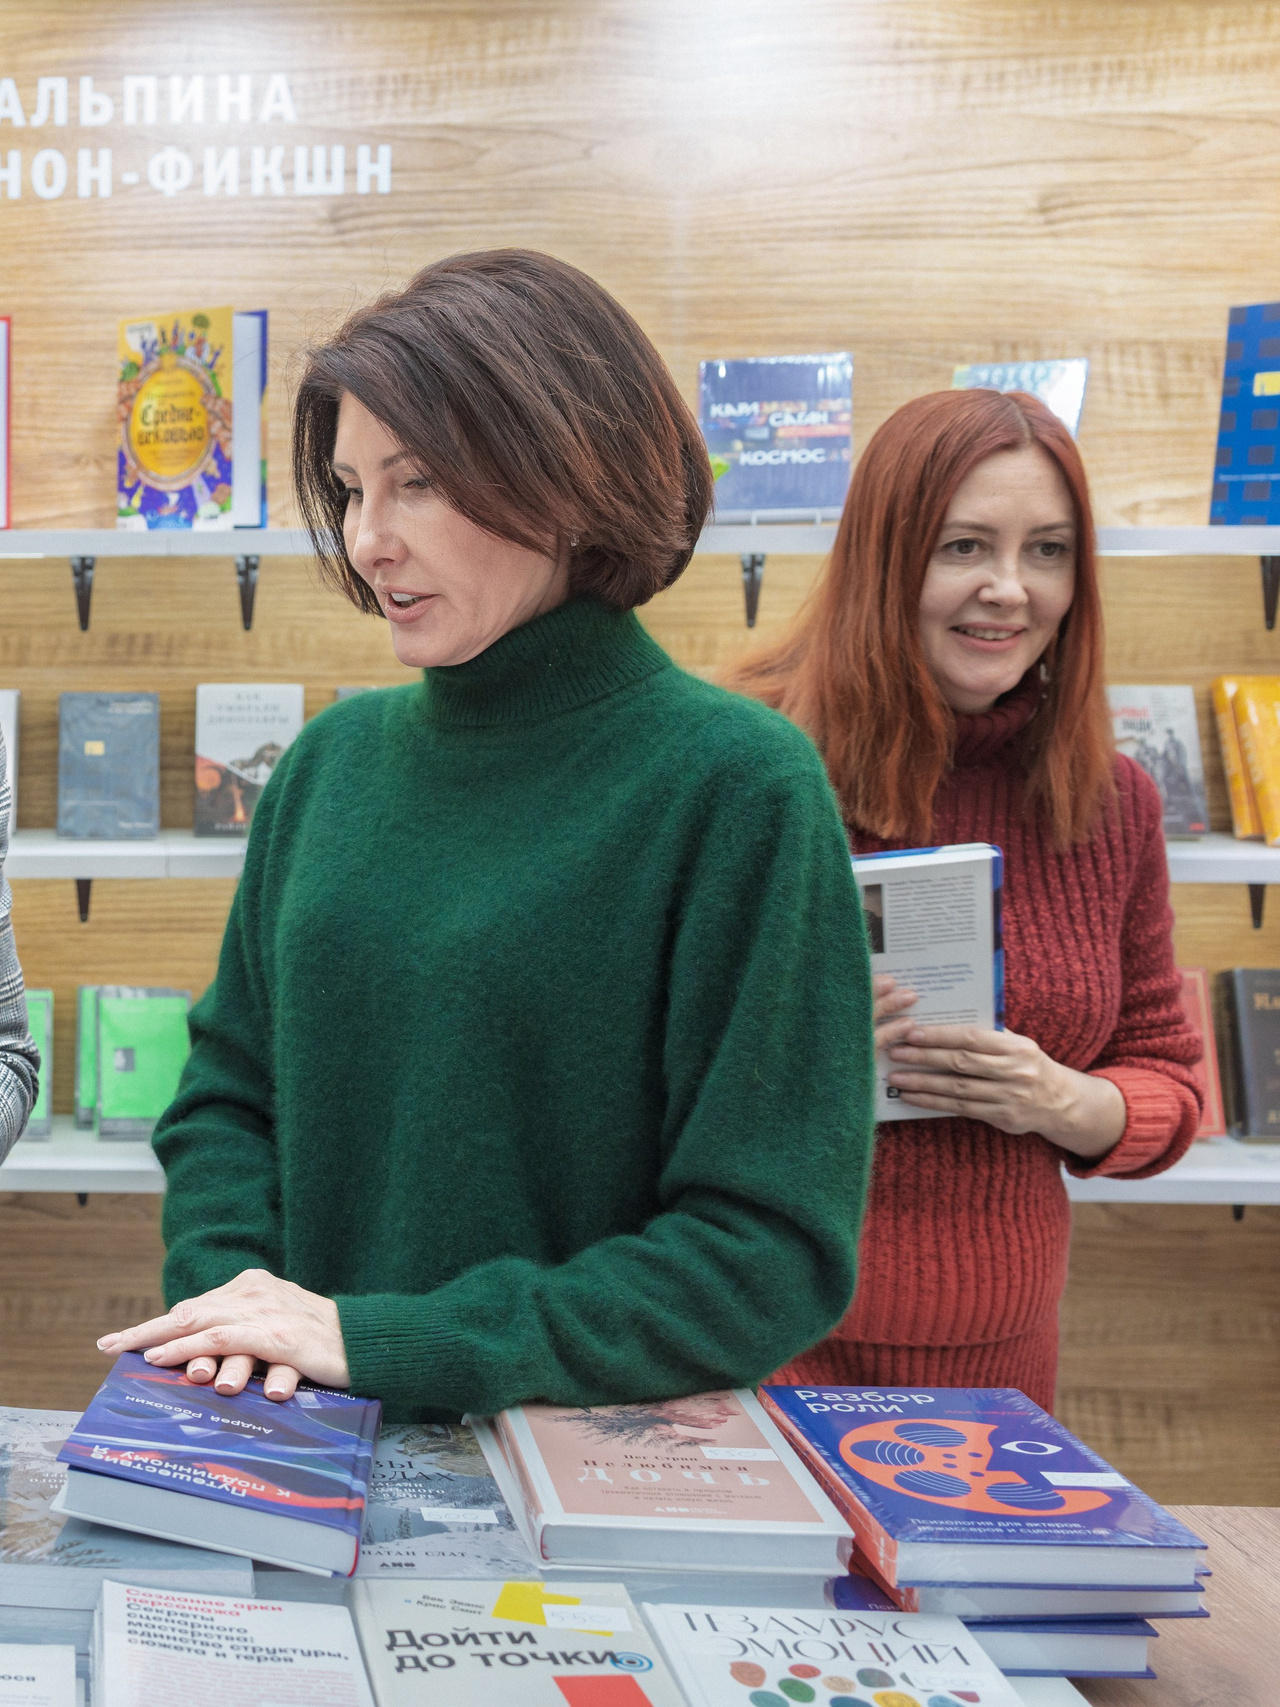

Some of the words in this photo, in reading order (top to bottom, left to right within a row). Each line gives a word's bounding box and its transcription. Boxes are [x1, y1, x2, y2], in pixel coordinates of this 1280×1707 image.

[738, 448, 828, 466] КОСМОС
[299, 1385, 356, 1402] Практика
[794, 1390, 935, 1405] Разбор
[124, 1394, 203, 1419] Россохин
[805, 1402, 904, 1414] роли
[211, 1414, 274, 1435] Андрей
[91, 1443, 110, 1457] Я
[90, 1451, 248, 1499] Путешествие
[120, 1450, 265, 1491] подлинному
[372, 1471, 456, 1481] ЬДАХ
[583, 1459, 748, 1472] Нелюбимая
[910, 1518, 995, 1528] Психология
[997, 1520, 1021, 1529] для
[126, 1588, 226, 1608] Создание
[233, 1601, 283, 1612] арки
[126, 1596, 241, 1617] персонажа
[416, 1600, 447, 1610] Крис
[451, 1605, 484, 1615] Смит
[126, 1603, 215, 1622] Секреты
[127, 1612, 249, 1634] сценарного
[127, 1620, 255, 1644] мастерства:
[672, 1610, 933, 1642] ТЕЗАУРУС
[127, 1629, 222, 1649] единство
[385, 1627, 538, 1651] Дойти
[128, 1638, 207, 1656] сюжета
[215, 1651, 227, 1659] и
[236, 1652, 295, 1663] героя
[709, 1635, 972, 1667] ЭМОЦИЙ
[395, 1654, 456, 1673] до
[471, 1650, 621, 1668] точки
